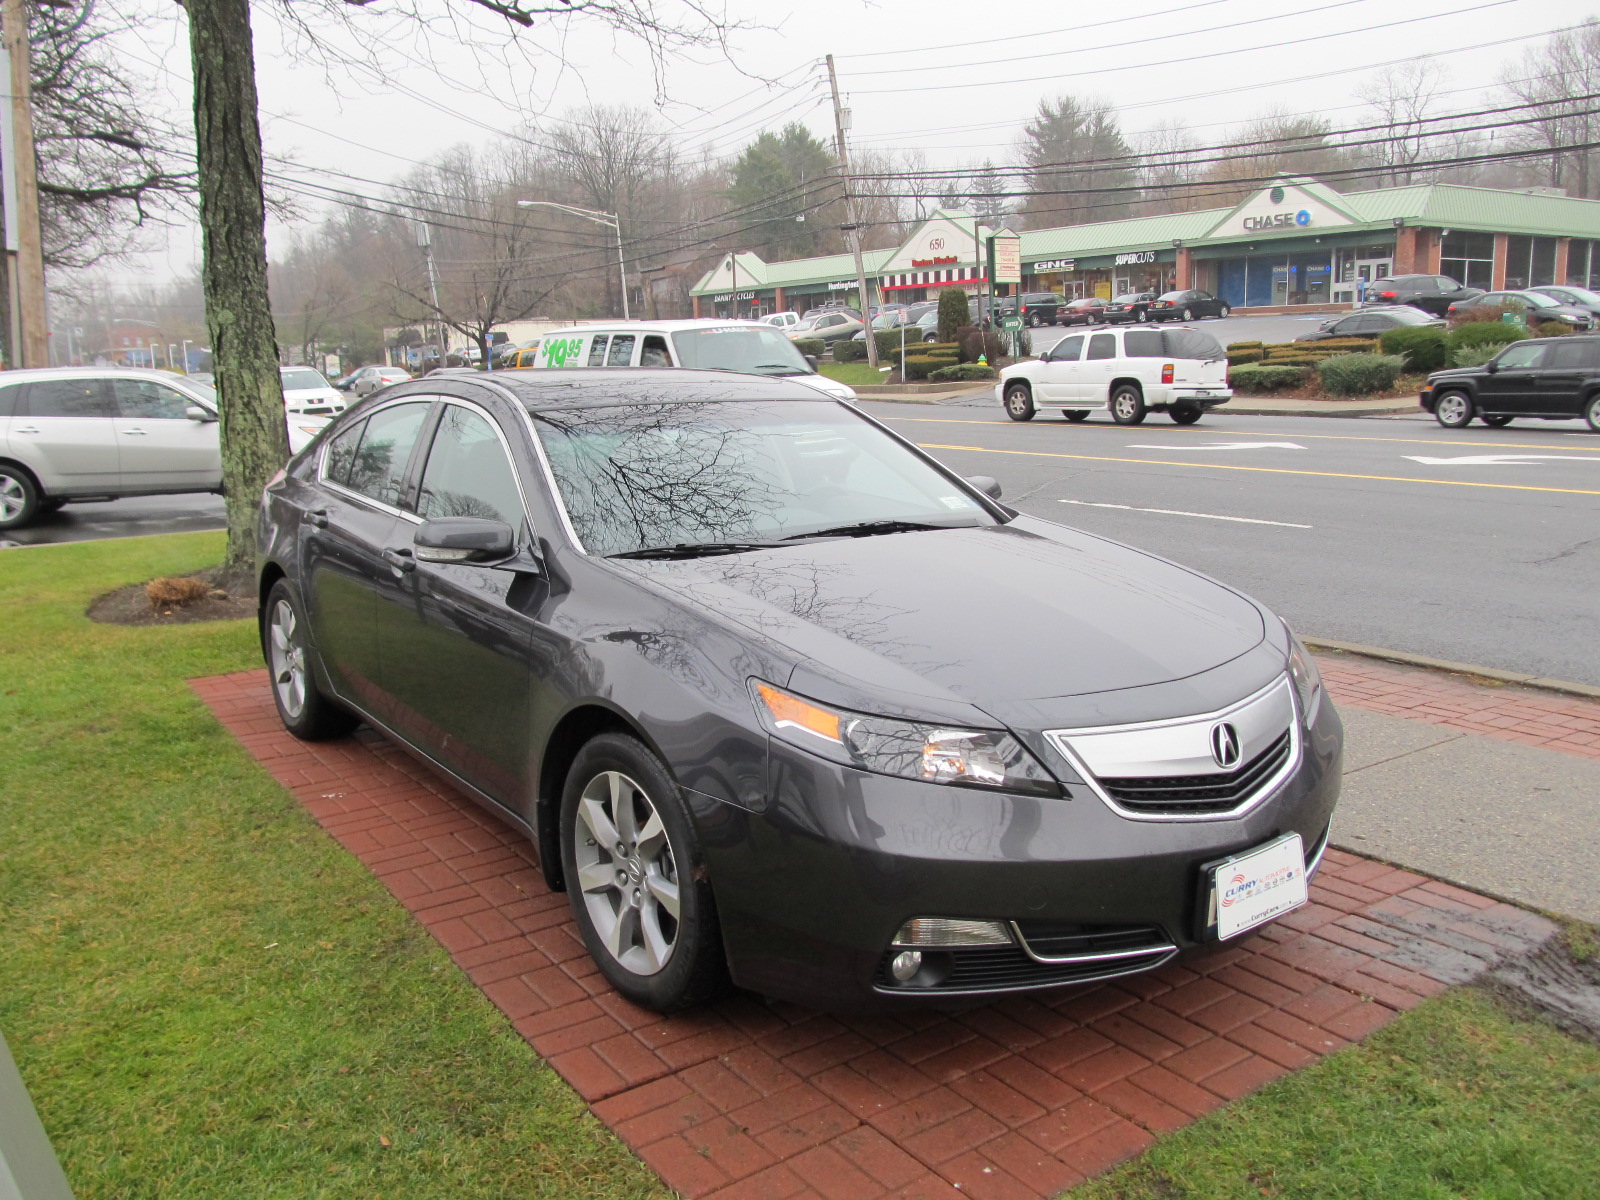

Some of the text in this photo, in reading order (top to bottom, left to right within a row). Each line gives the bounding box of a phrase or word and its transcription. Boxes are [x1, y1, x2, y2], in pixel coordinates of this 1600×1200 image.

[1243, 212, 1295, 230] CHASE
[929, 237, 945, 251] 650
[933, 255, 958, 265] Market
[1034, 259, 1075, 270] GNC
[1115, 251, 1155, 266] SUPERCUTS
[1005, 320, 1018, 328] ENTER
[1226, 878, 1258, 898] CURRY
